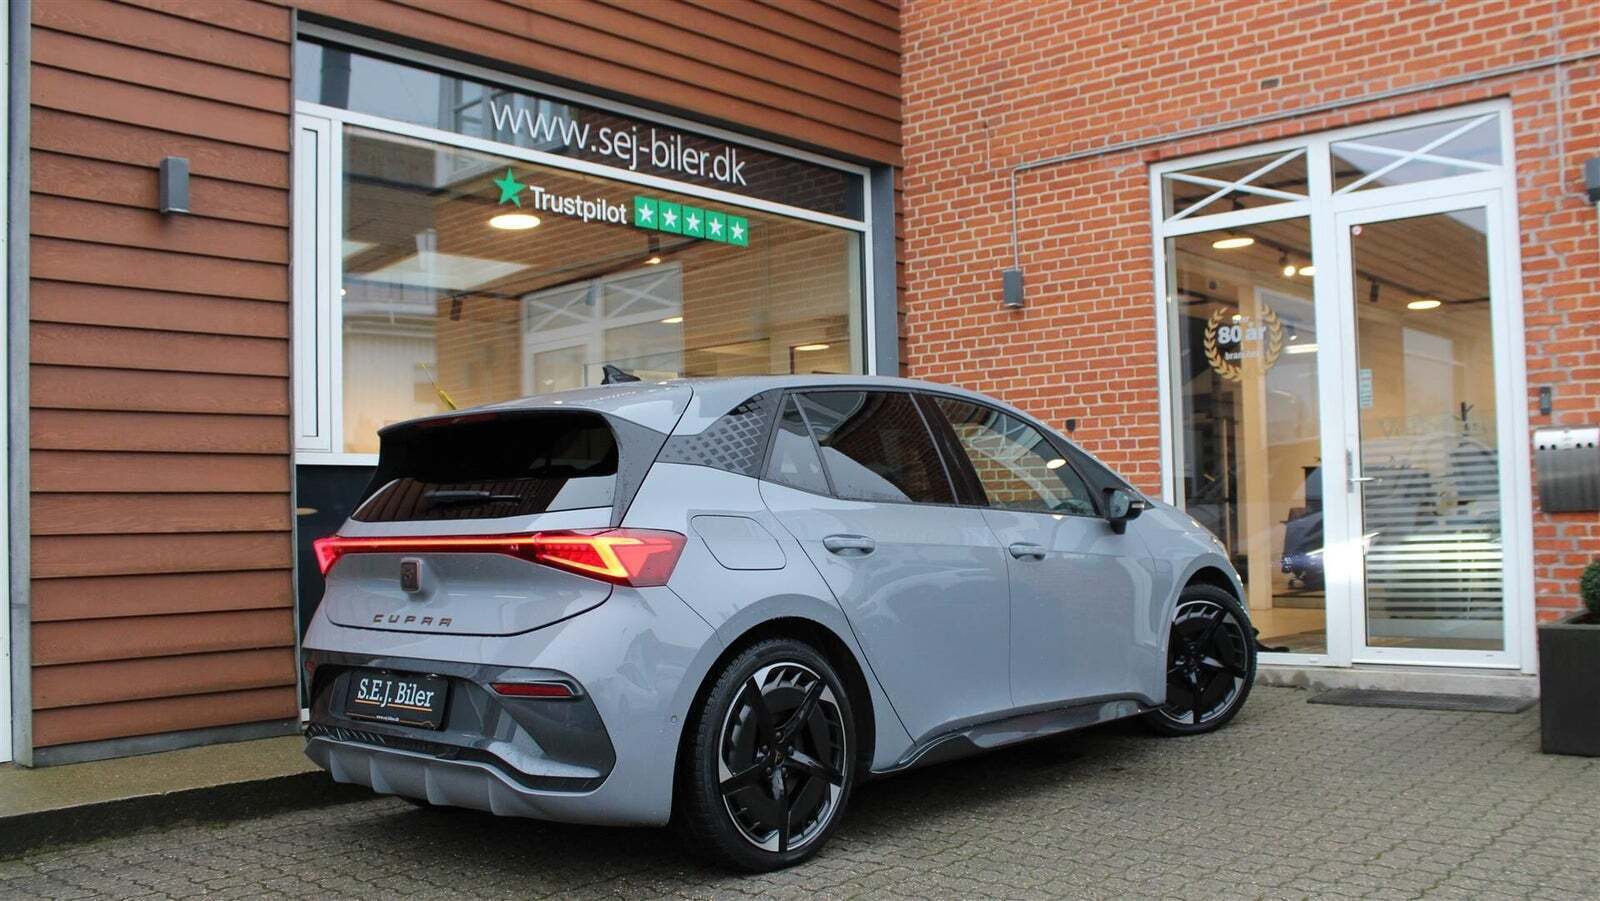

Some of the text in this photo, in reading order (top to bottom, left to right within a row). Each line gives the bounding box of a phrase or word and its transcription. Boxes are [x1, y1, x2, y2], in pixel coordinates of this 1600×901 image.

[490, 100, 747, 186] www.sej-biler.dk
[529, 185, 628, 224] Trustpilot
[1218, 326, 1242, 344] 80
[373, 613, 452, 628] CUPRA
[357, 678, 435, 708] S.E.J. Biler
